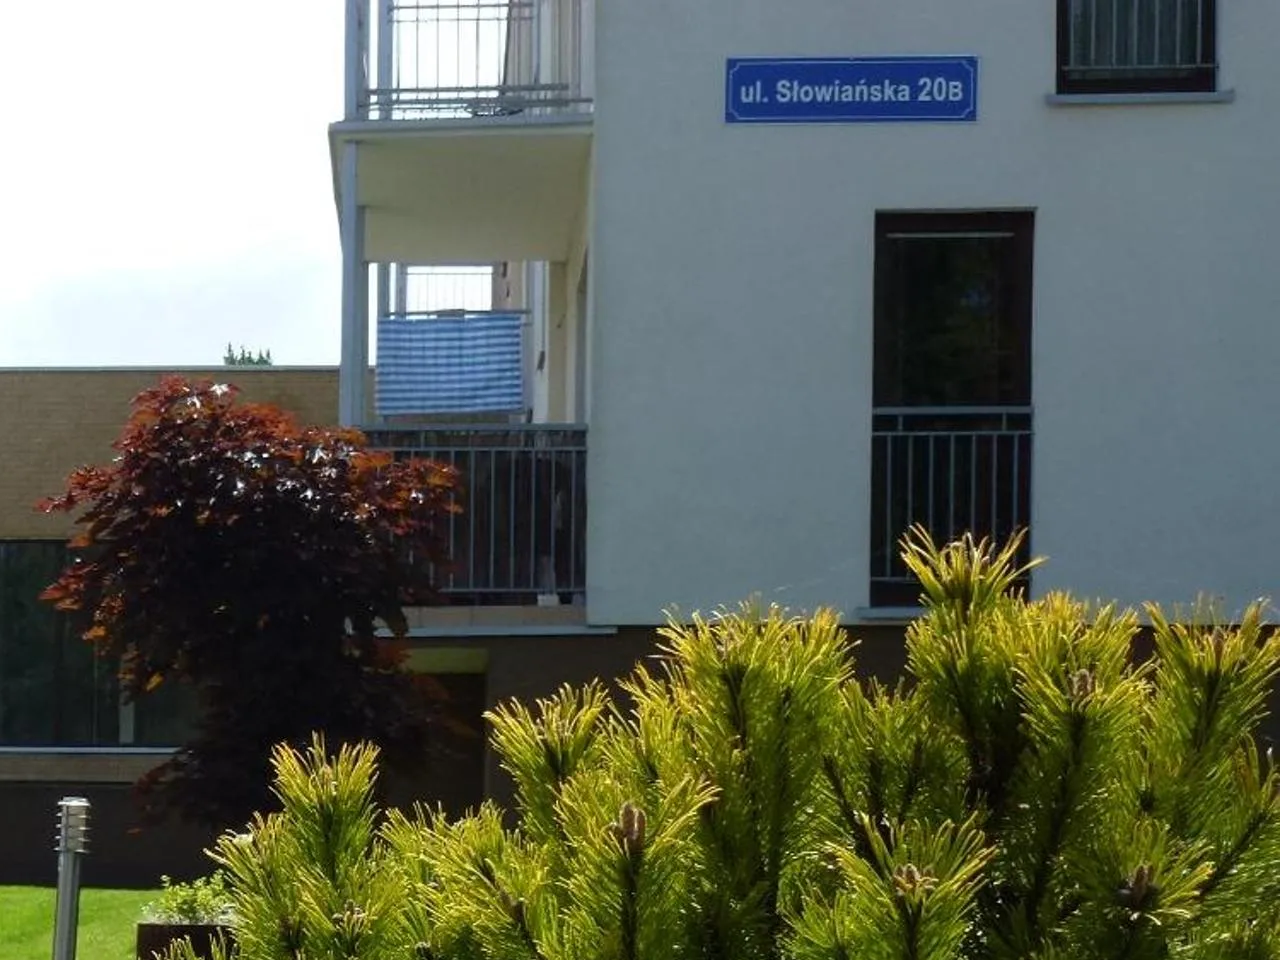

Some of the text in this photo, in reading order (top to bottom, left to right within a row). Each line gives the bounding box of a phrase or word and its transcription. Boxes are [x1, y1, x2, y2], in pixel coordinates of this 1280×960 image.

[739, 77, 965, 104] ul. Słowiańska 20B
